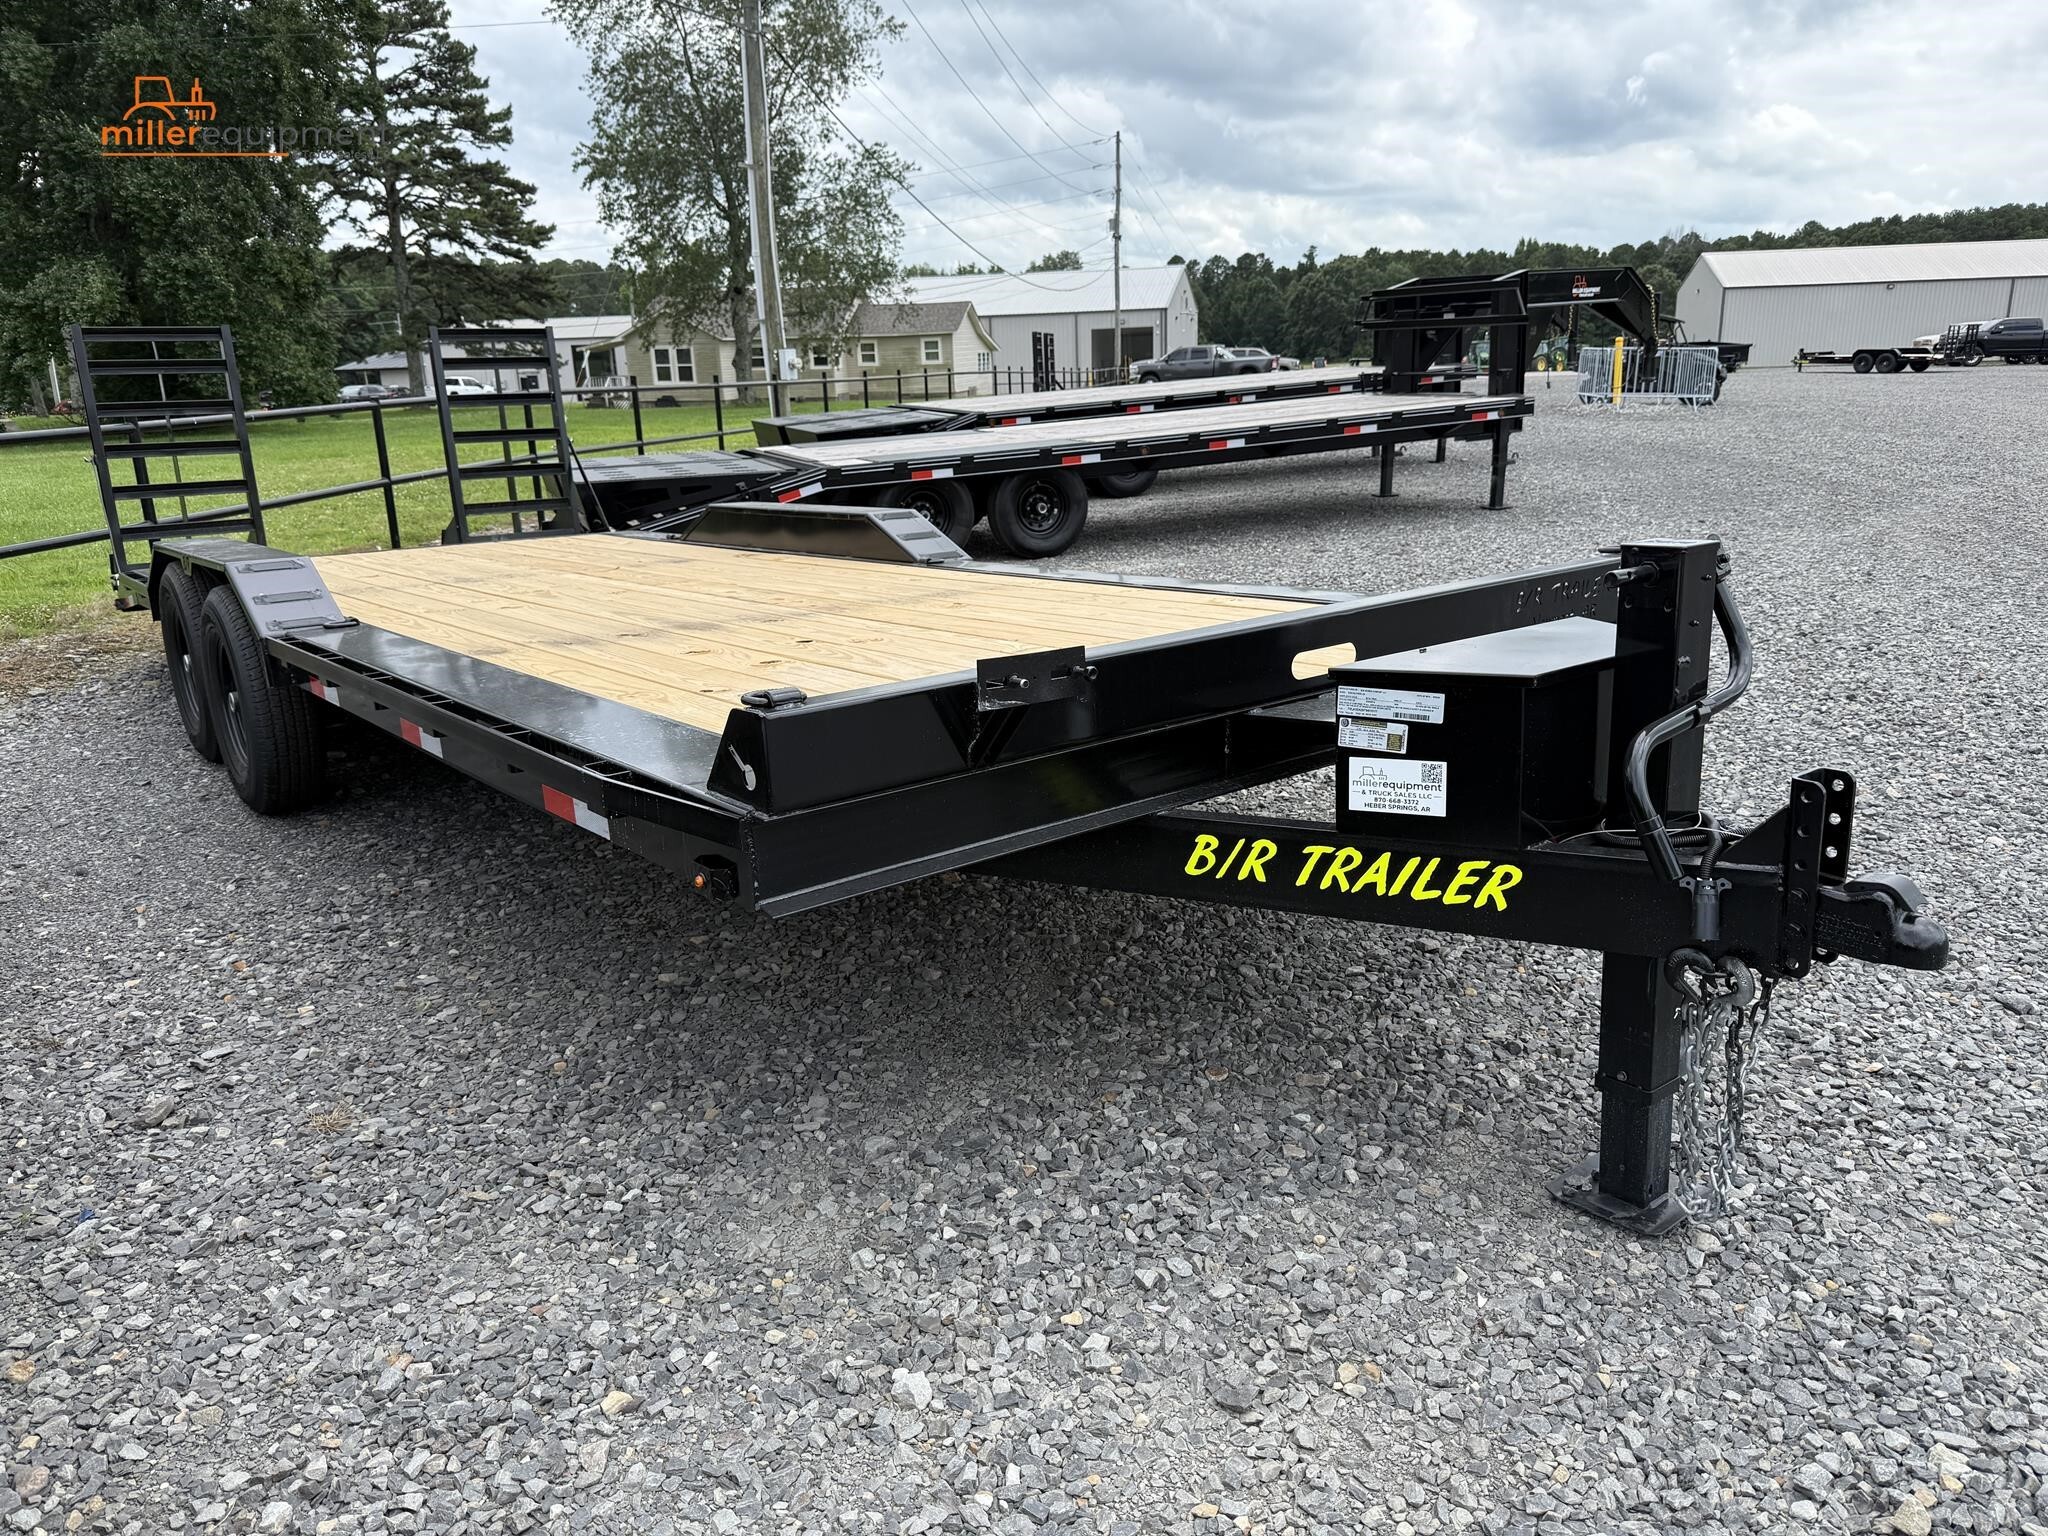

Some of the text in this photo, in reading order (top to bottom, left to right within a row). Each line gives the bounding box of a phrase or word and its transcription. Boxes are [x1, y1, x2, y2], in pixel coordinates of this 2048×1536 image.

[1352, 778, 1442, 792] millerequipment
[1369, 789, 1393, 798] TRUCK
[1394, 791, 1418, 799] SALES
[1419, 792, 1432, 800] LLC
[1364, 802, 1387, 810] HEBER
[1388, 803, 1420, 812] SPRINGS,
[1184, 834, 1523, 912] B/R TRAILER
